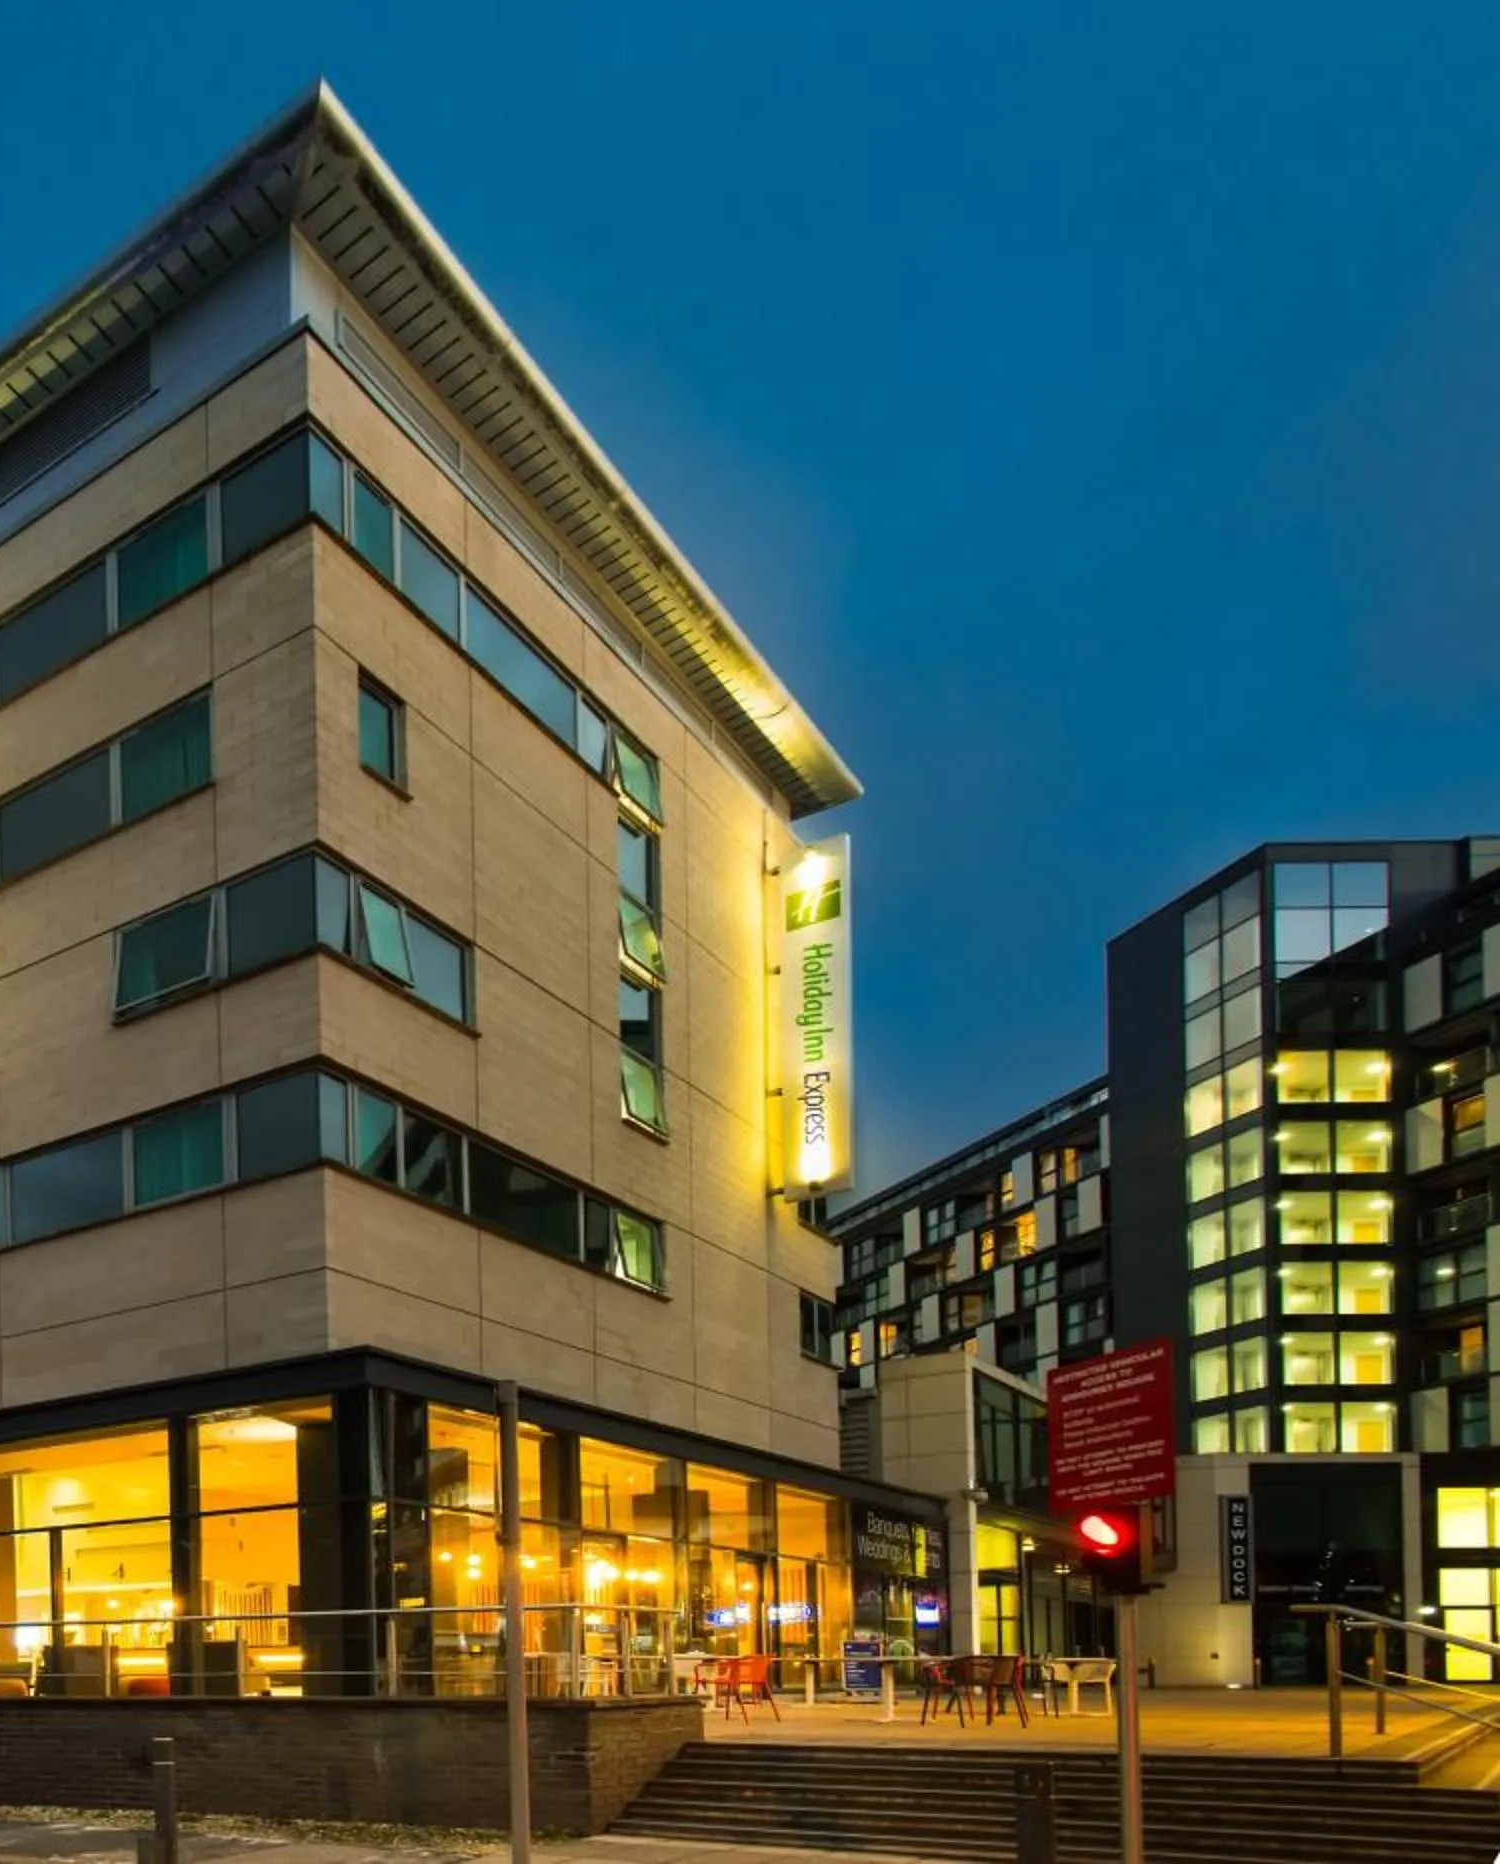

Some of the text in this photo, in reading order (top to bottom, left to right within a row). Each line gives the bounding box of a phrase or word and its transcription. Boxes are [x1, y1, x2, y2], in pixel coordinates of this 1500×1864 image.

[795, 943, 835, 1145] Holiday Inn Express
[1231, 1503, 1247, 1596] NEW DOCK
